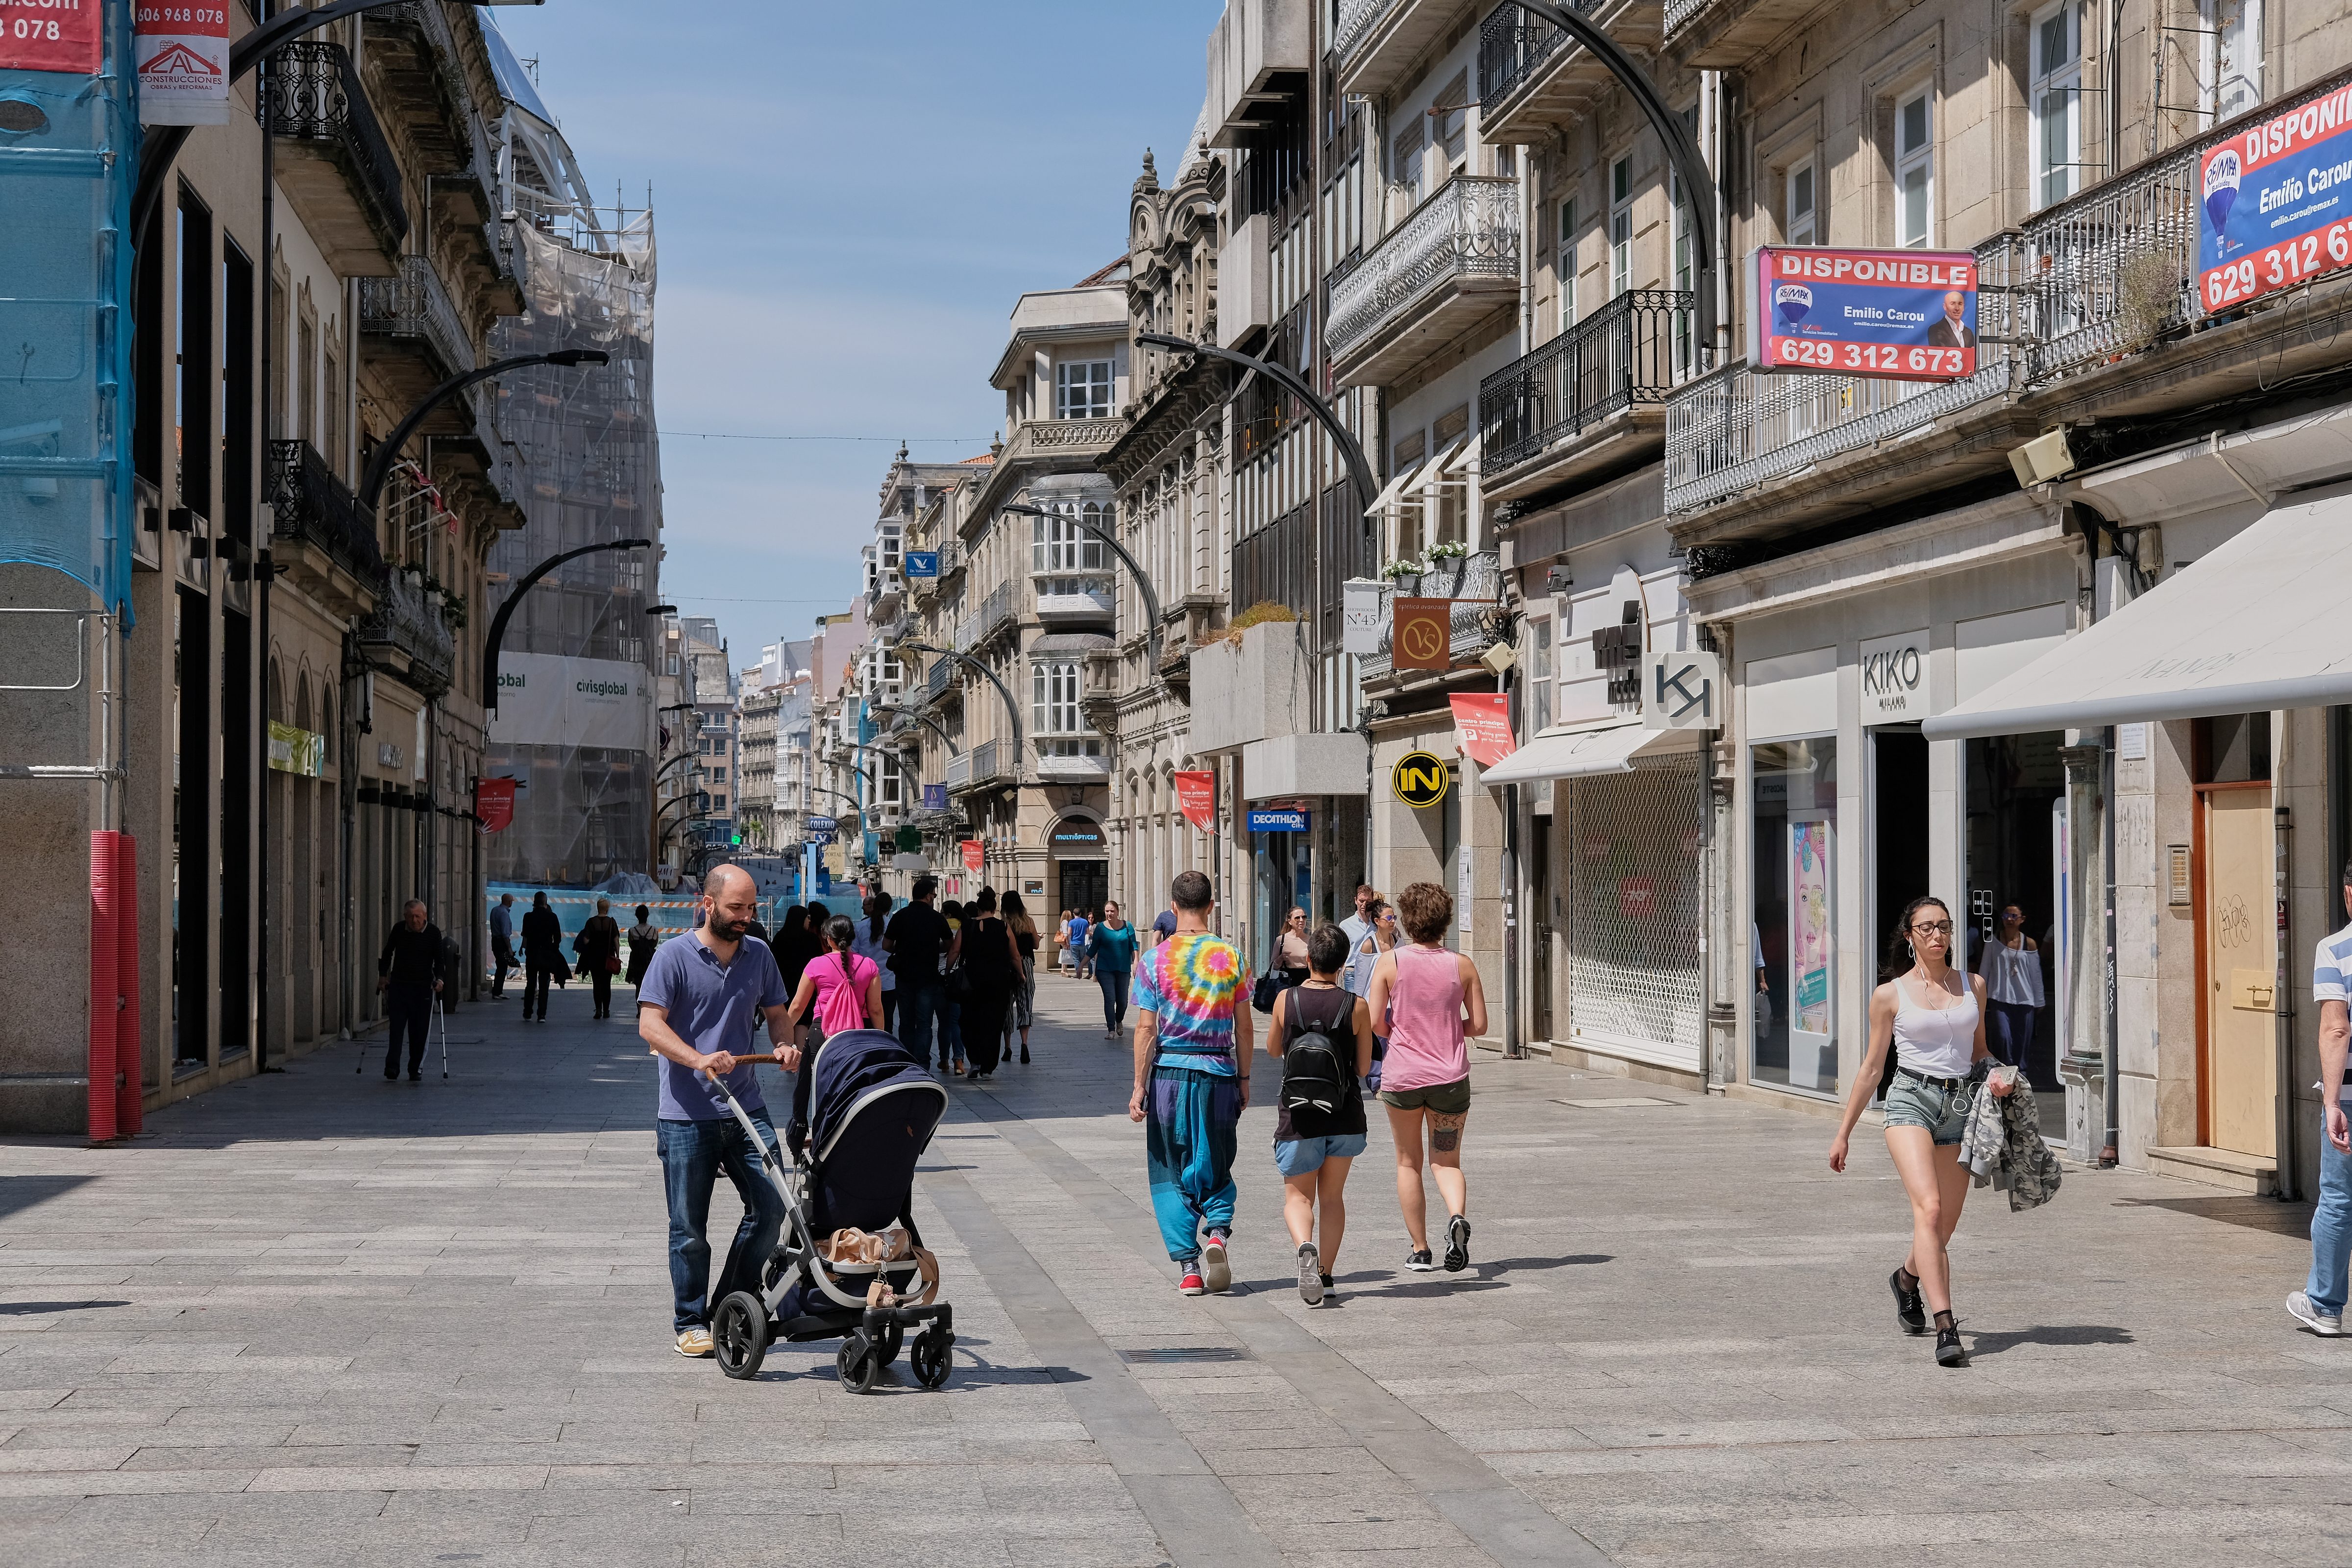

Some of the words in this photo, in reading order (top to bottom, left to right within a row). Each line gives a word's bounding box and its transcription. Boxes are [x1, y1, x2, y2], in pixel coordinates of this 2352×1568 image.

[138, 8, 160, 22] 606
[165, 8, 191, 22] 968
[197, 8, 223, 24] 078
[14, 18, 60, 40] 078
[139, 76, 222, 84] CONSTRUCCIONES
[2207, 156, 2237, 186] RE/MAX
[2259, 177, 2303, 214] Emilio
[2307, 160, 2352, 195] Carou
[2271, 196, 2339, 228] emilio.carou@remax.es
[1782, 255, 1968, 285] DISPONIBLE
[2208, 260, 2256, 306] 629
[2264, 236, 2321, 284] 312
[1780, 288, 1809, 300] RE/MAX
[1843, 306, 1884, 319] Emilio
[1887, 307, 1925, 321] Carou
[1782, 339, 1834, 365] 629
[1844, 344, 1899, 369] 312
[1909, 348, 1963, 372] 673
[1864, 647, 1919, 691] KIKO
[576, 678, 627, 696] civisglobal
[1879, 695, 1904, 707] MILANO
[810, 820, 834, 829] COLEXIO
[1253, 815, 1304, 823] DECATHLON
